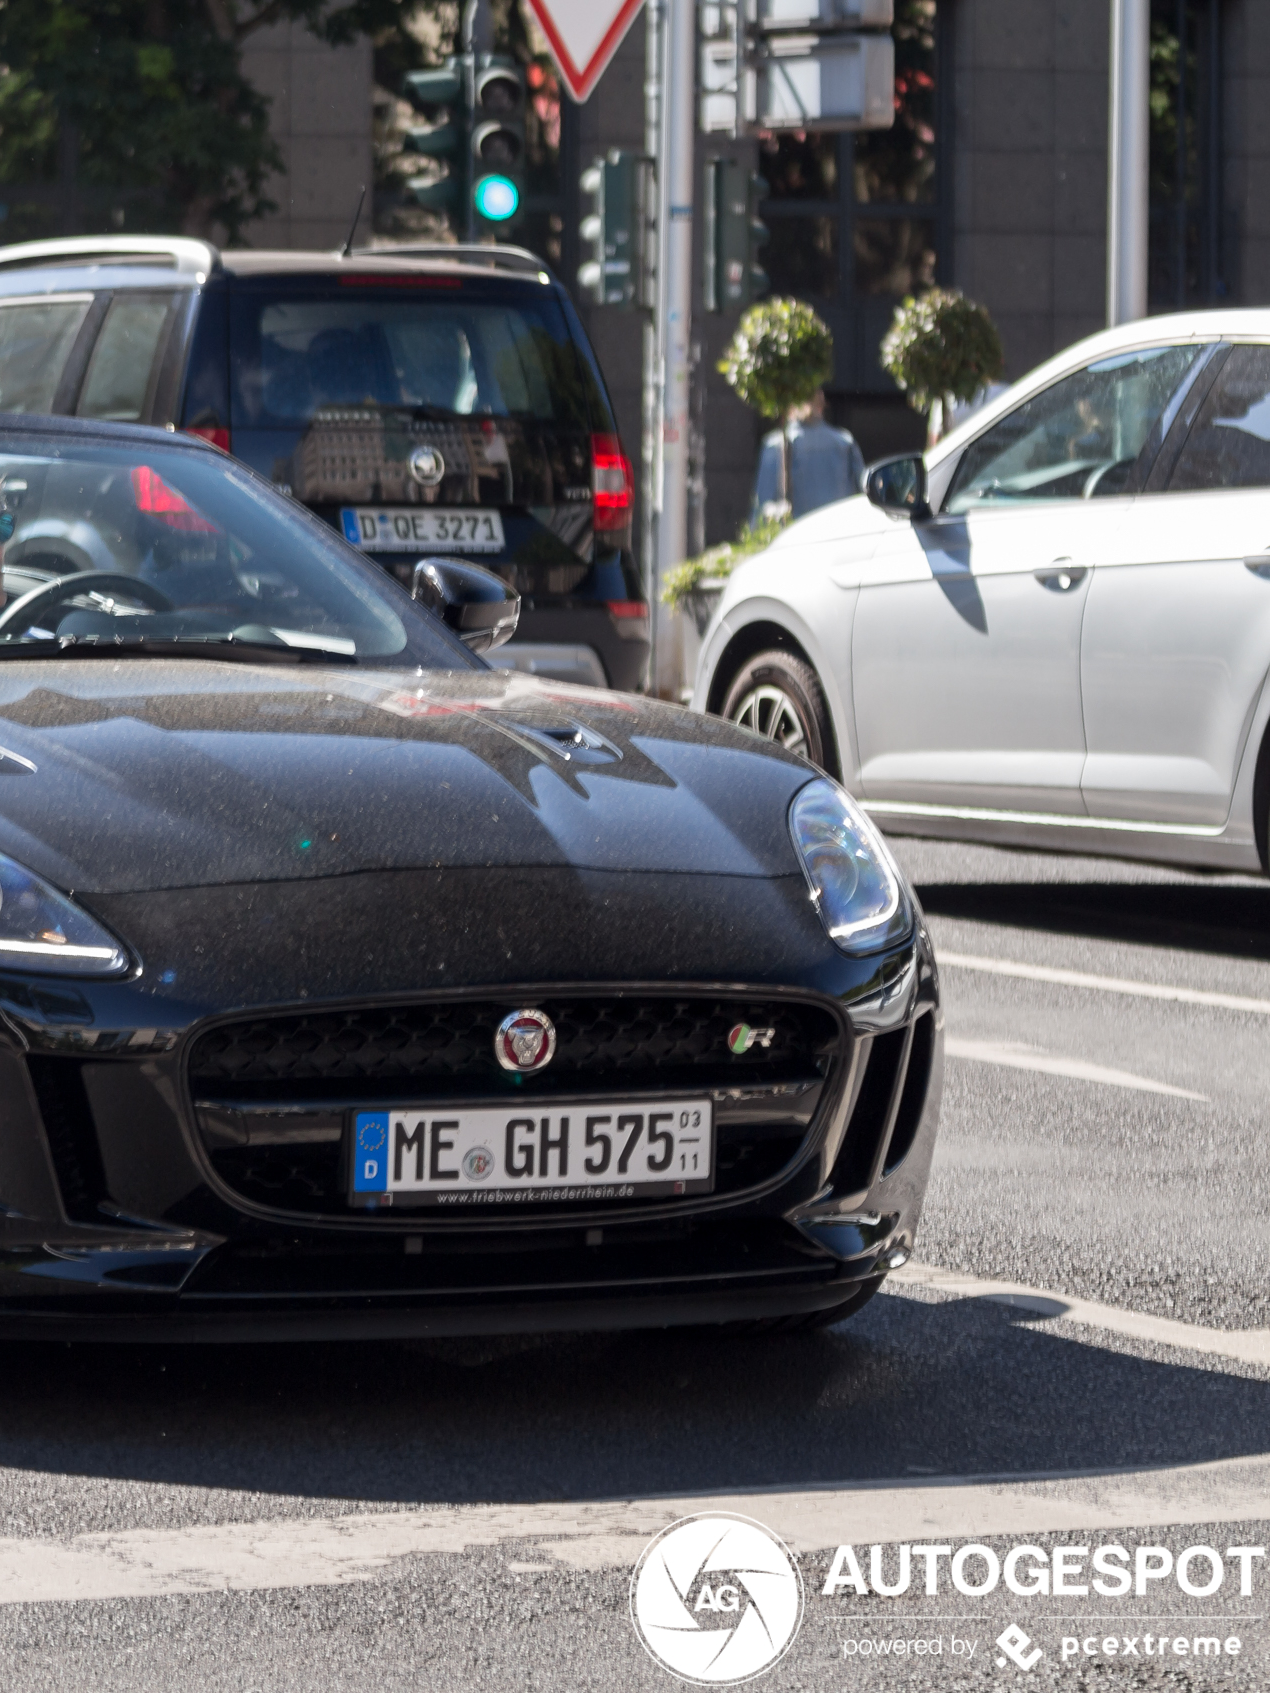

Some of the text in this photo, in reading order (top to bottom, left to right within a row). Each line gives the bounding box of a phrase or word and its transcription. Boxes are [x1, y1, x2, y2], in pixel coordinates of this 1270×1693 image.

[360, 512, 497, 541] D QE 3271
[680, 1109, 701, 1129] 03
[392, 1112, 675, 1182] ME GH 575
[364, 1160, 379, 1180] D
[680, 1152, 699, 1171] 11
